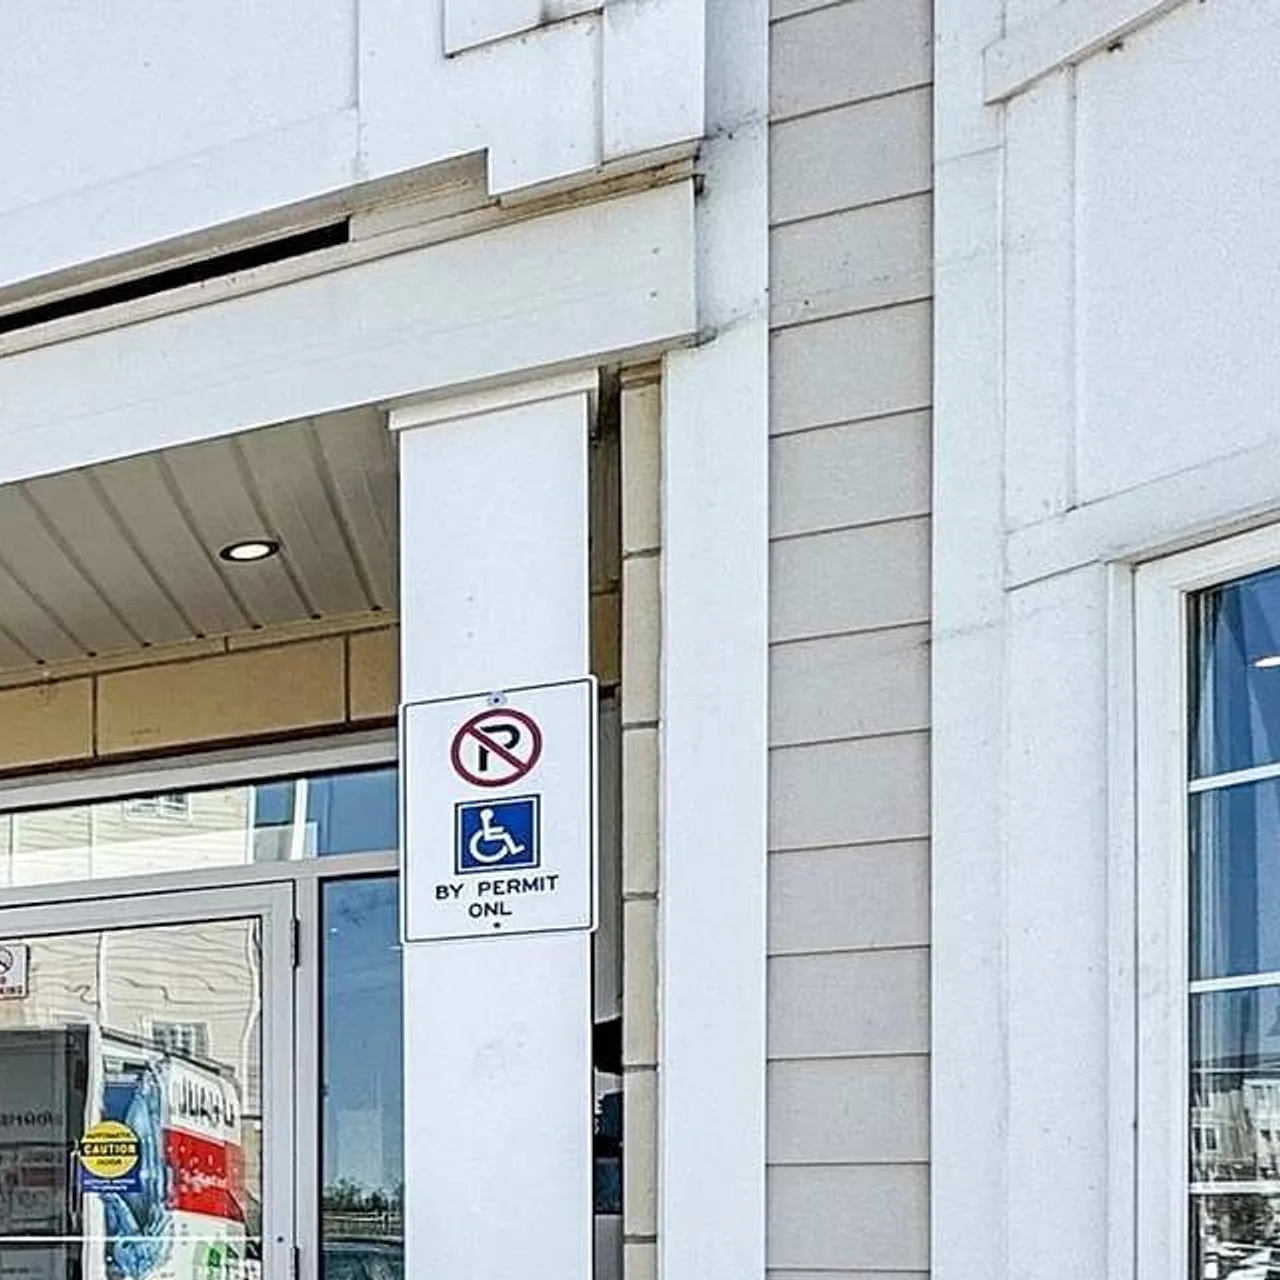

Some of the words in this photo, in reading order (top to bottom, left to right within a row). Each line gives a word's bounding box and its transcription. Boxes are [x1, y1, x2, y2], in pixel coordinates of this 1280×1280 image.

[435, 882, 466, 900] BY
[477, 874, 560, 898] PERMIT
[468, 901, 513, 918] ONL
[83, 1143, 136, 1155] CAUTION
